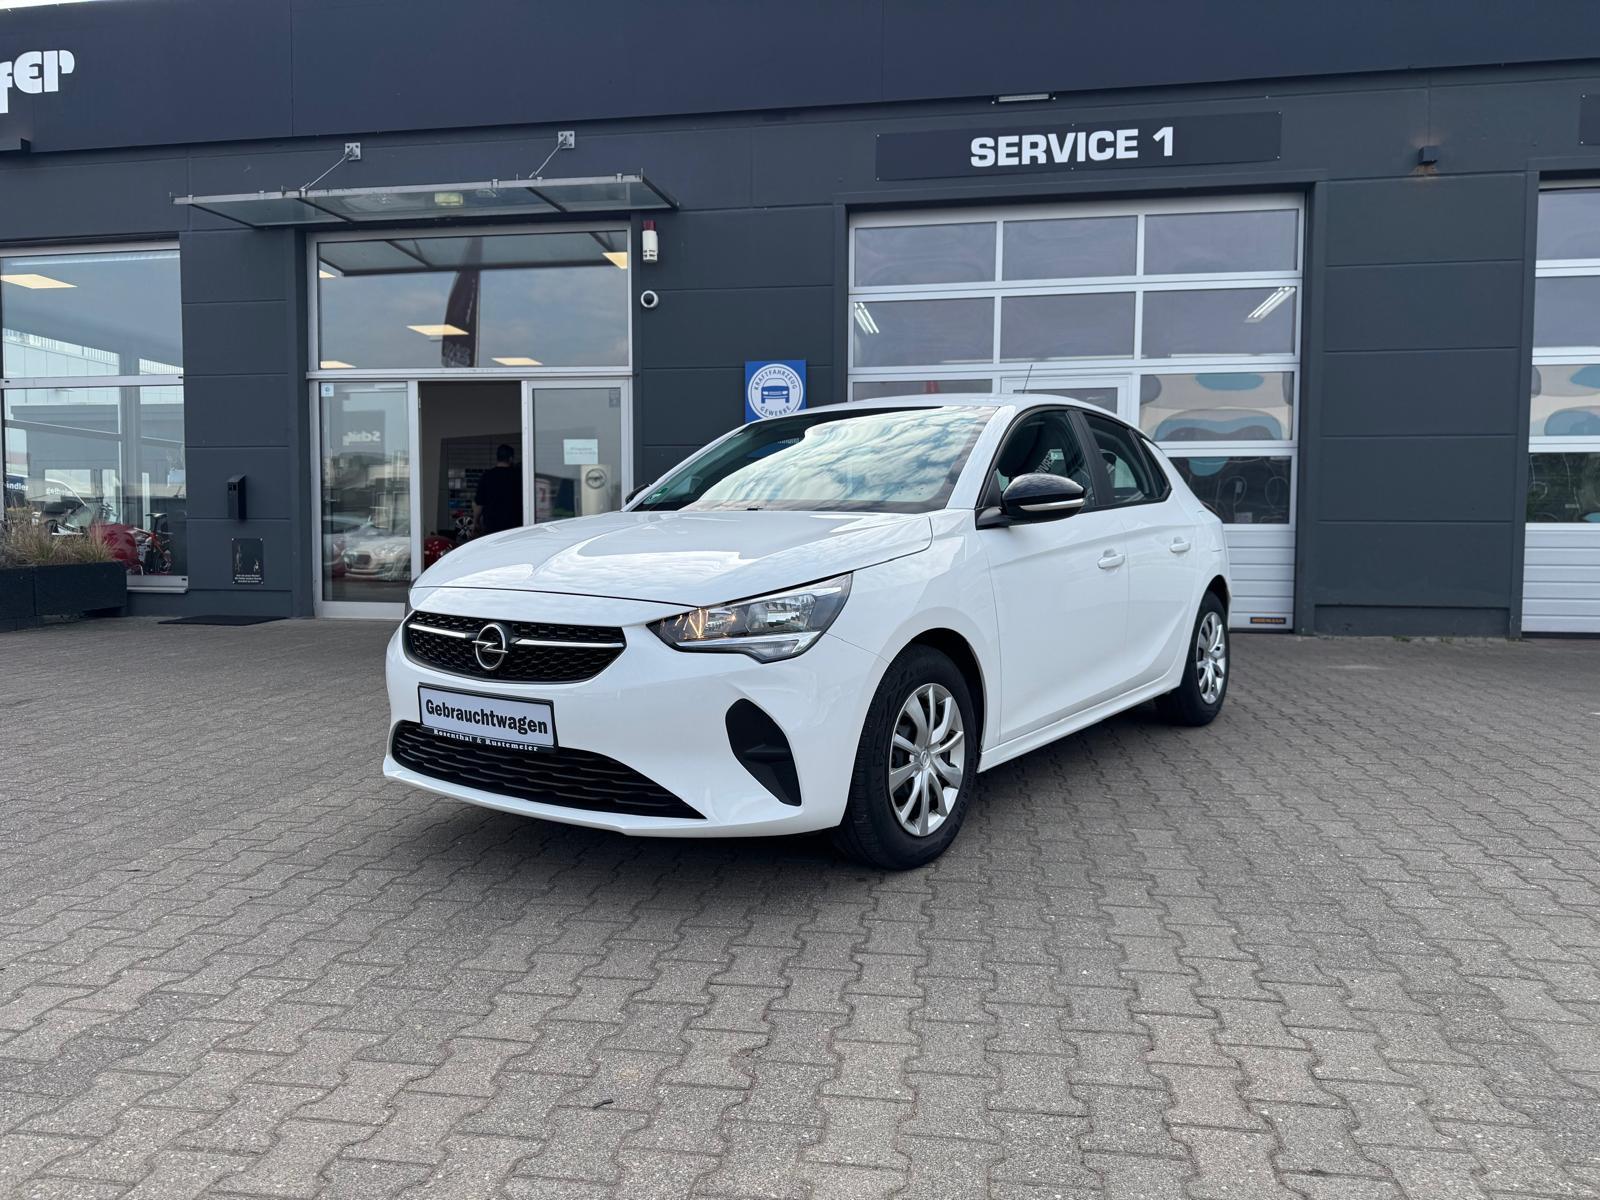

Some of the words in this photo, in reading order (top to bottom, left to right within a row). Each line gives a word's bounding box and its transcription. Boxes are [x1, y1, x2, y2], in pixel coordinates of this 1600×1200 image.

[970, 128, 1139, 167] SERVICE
[1152, 126, 1174, 156] 1
[754, 369, 798, 390] KRAFTFAHRZEUG
[760, 405, 792, 417] GEWERBE
[425, 698, 548, 735] Gebrauchtwagen
[433, 728, 473, 742] Rosenthal
[476, 736, 482, 744] &
[485, 736, 538, 752] Rustemeier
